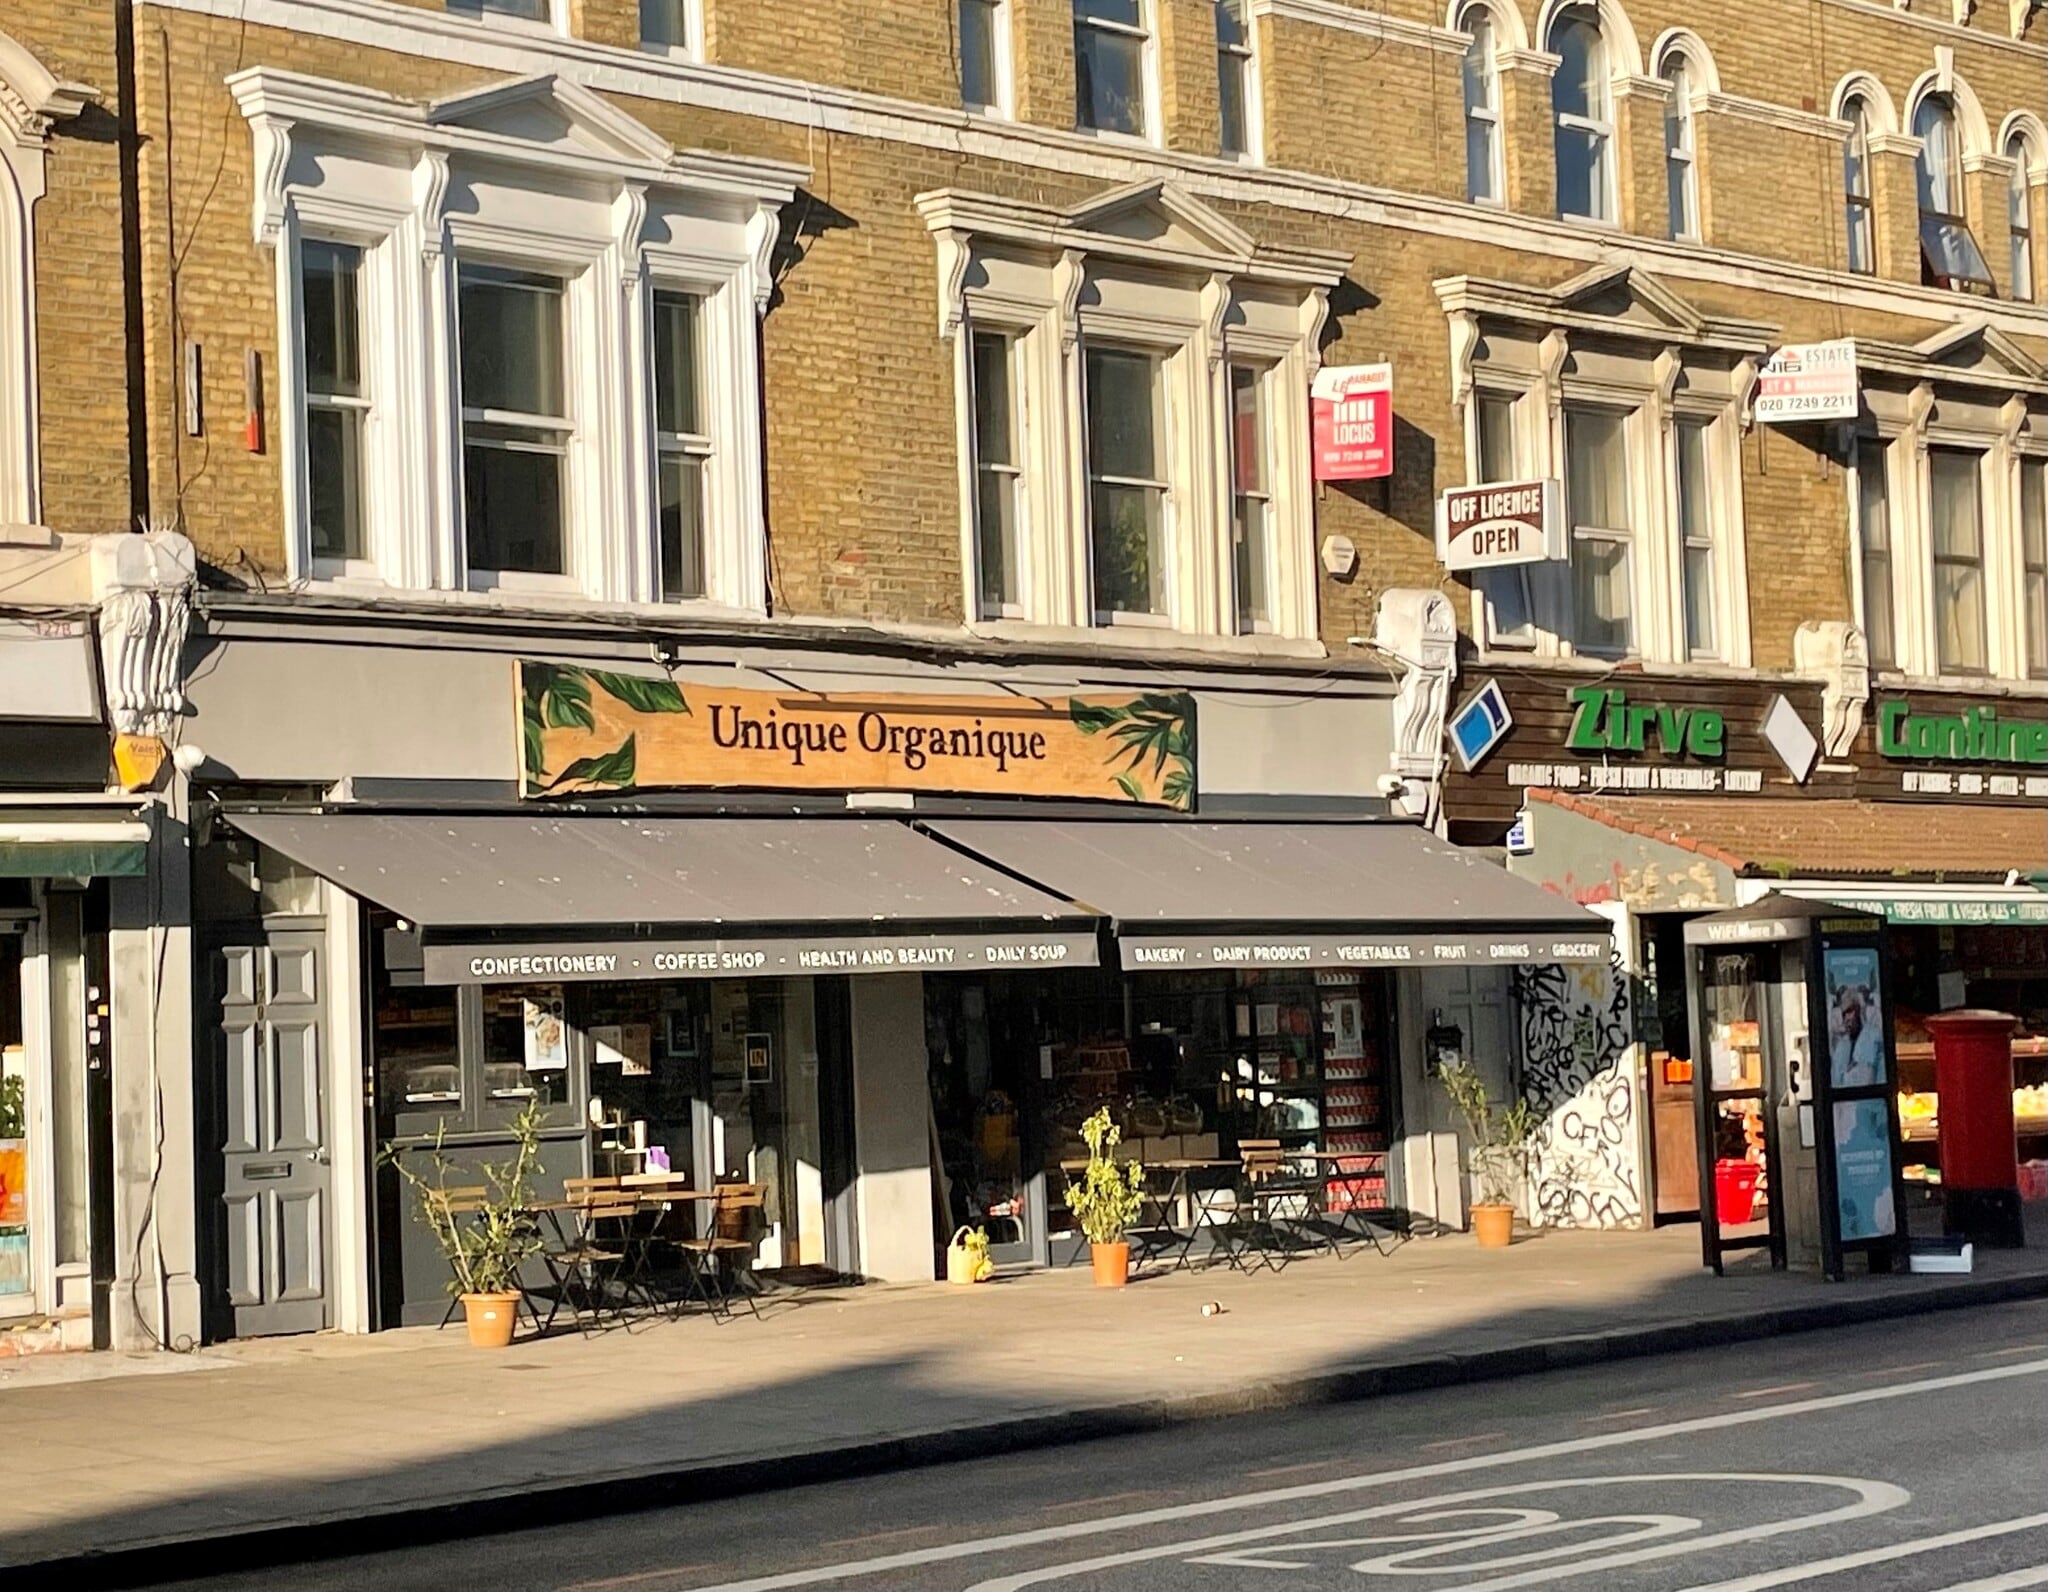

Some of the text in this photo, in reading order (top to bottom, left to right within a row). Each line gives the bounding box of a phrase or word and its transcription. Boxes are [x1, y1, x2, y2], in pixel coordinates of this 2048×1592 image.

[1806, 348, 1849, 362] ESTATE
[1760, 395, 1853, 411] 020 7249 2211
[1333, 422, 1376, 446] LOCUS
[1450, 489, 1540, 523] OFF LICENCE
[1473, 527, 1519, 555] OPEN
[1567, 687, 1723, 757] Zirve
[1877, 700, 2048, 764] Contine
[707, 704, 1047, 772] Unique Organique
[469, 945, 1067, 975] CONFECTIONERY COFFEE SHOP HEALTH AND BEAUTY DAILY SOUP
[1134, 943, 1601, 962] BAKERY DAIRY PRODUCT VEGETABLES FRUIT DRINKS GROCERY
